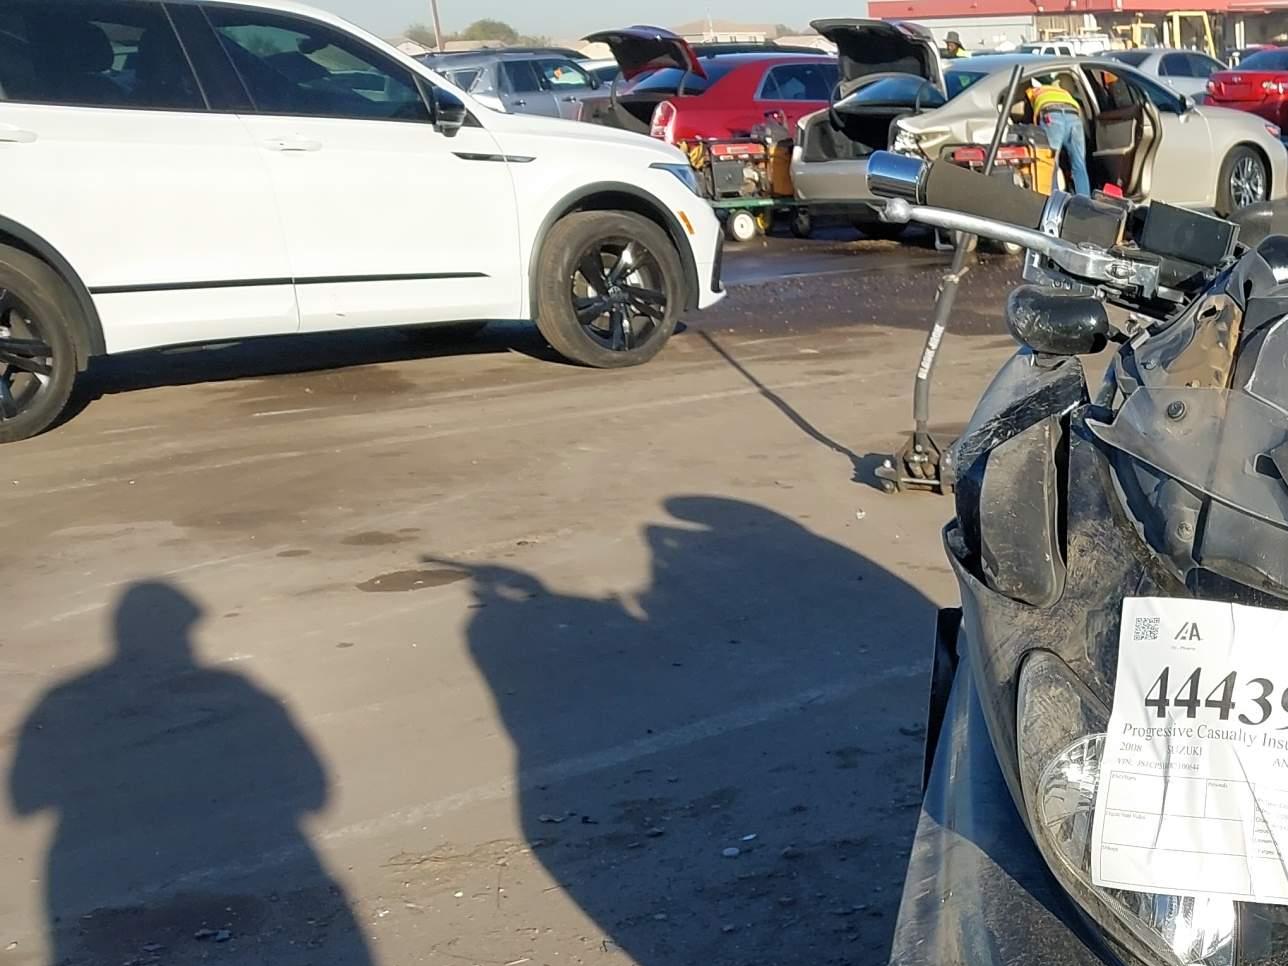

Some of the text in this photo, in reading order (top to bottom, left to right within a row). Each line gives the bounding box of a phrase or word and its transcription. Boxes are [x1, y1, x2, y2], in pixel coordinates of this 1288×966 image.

[1122, 722, 1193, 742] Progressive
[1197, 724, 1257, 748] Casualty
[1119, 741, 1203, 757] 2008 SUZUKI
